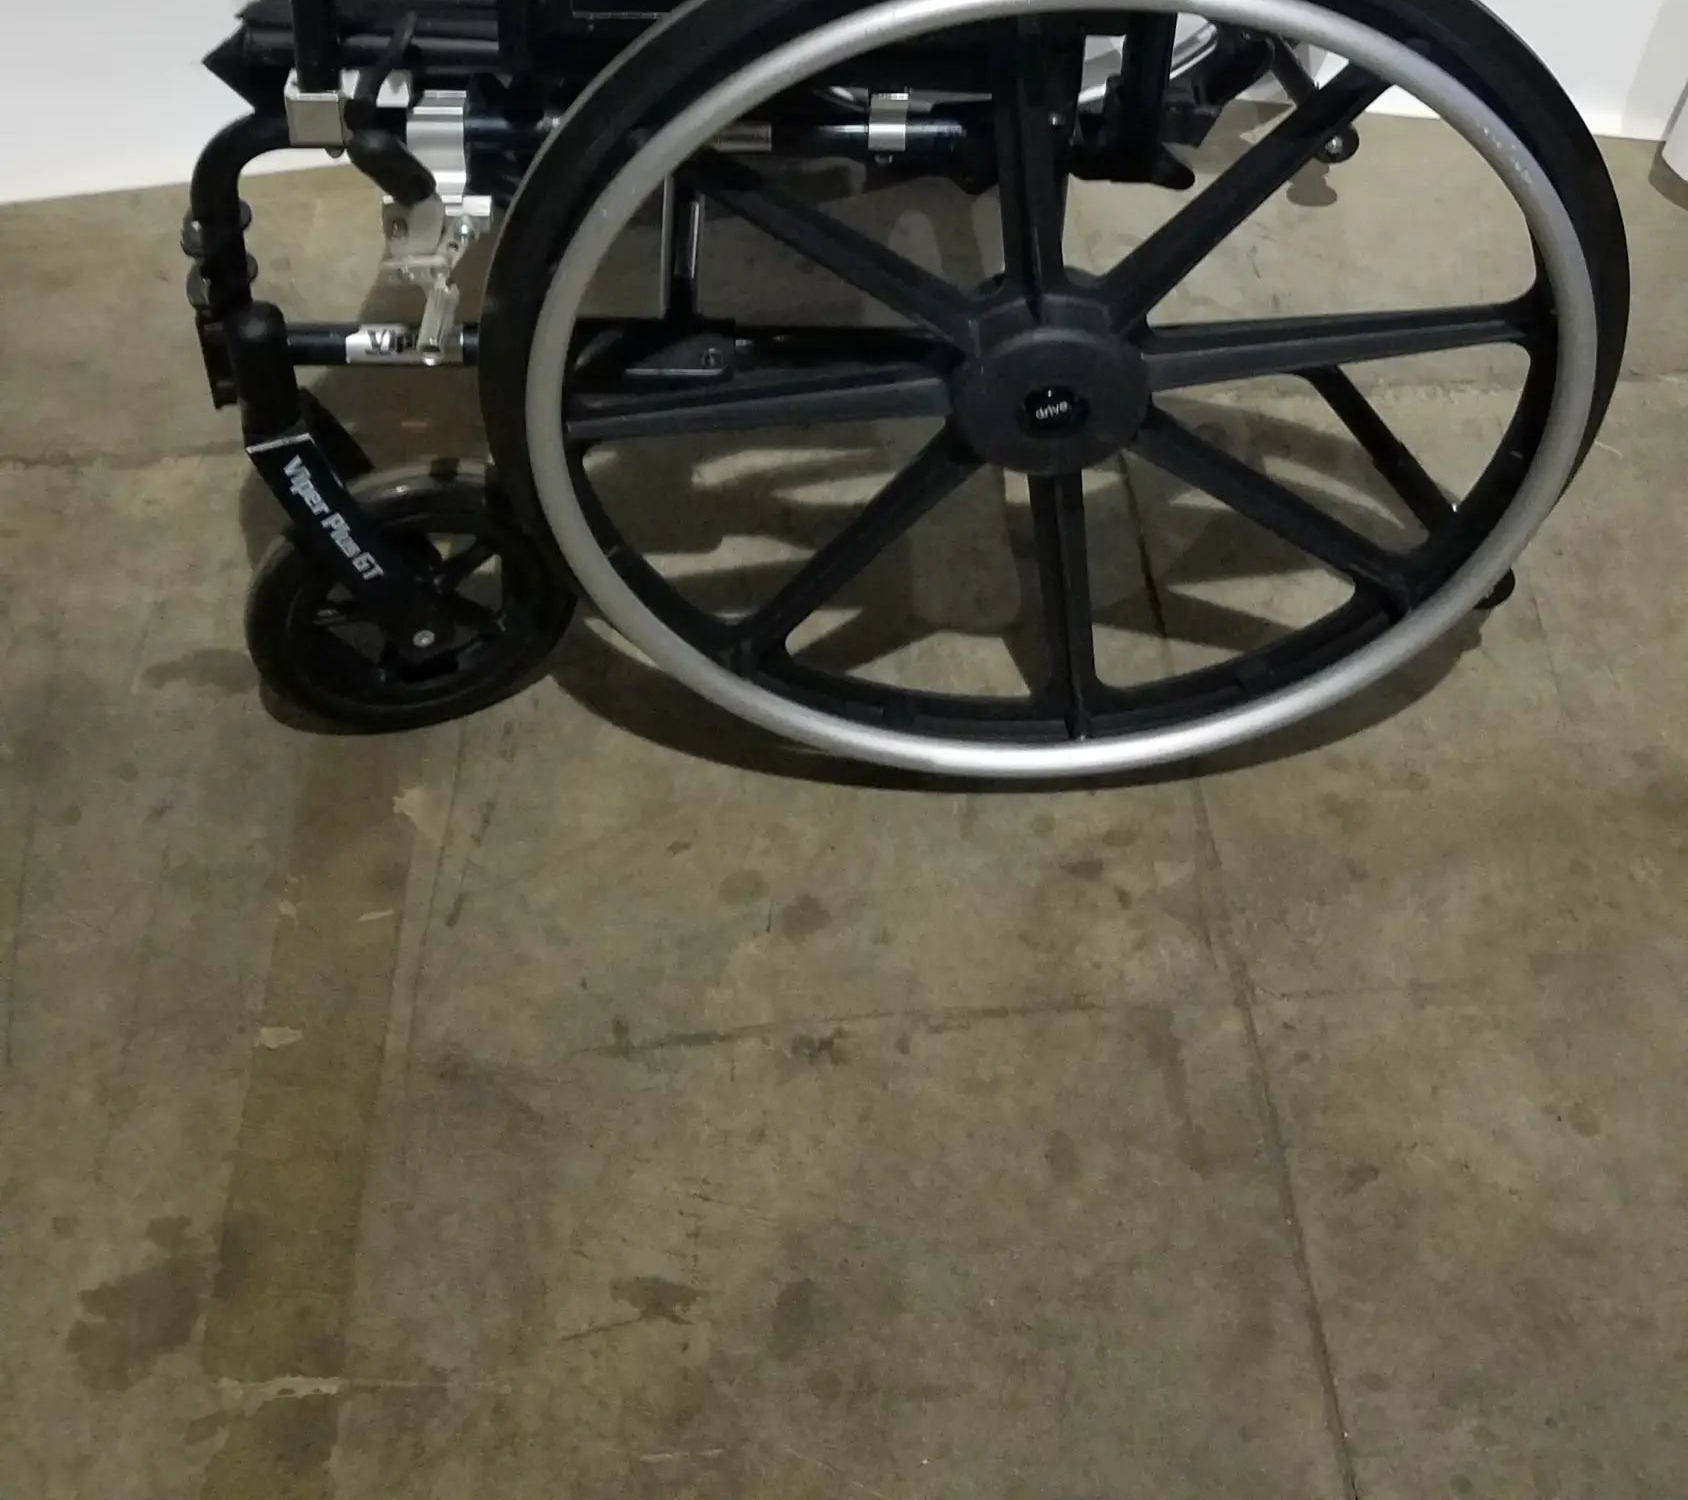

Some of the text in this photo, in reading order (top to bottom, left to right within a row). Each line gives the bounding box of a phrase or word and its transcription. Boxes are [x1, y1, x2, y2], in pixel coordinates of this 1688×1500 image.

[1035, 400, 1068, 420] drive
[283, 454, 330, 516] Viper
[352, 551, 385, 581] GT
